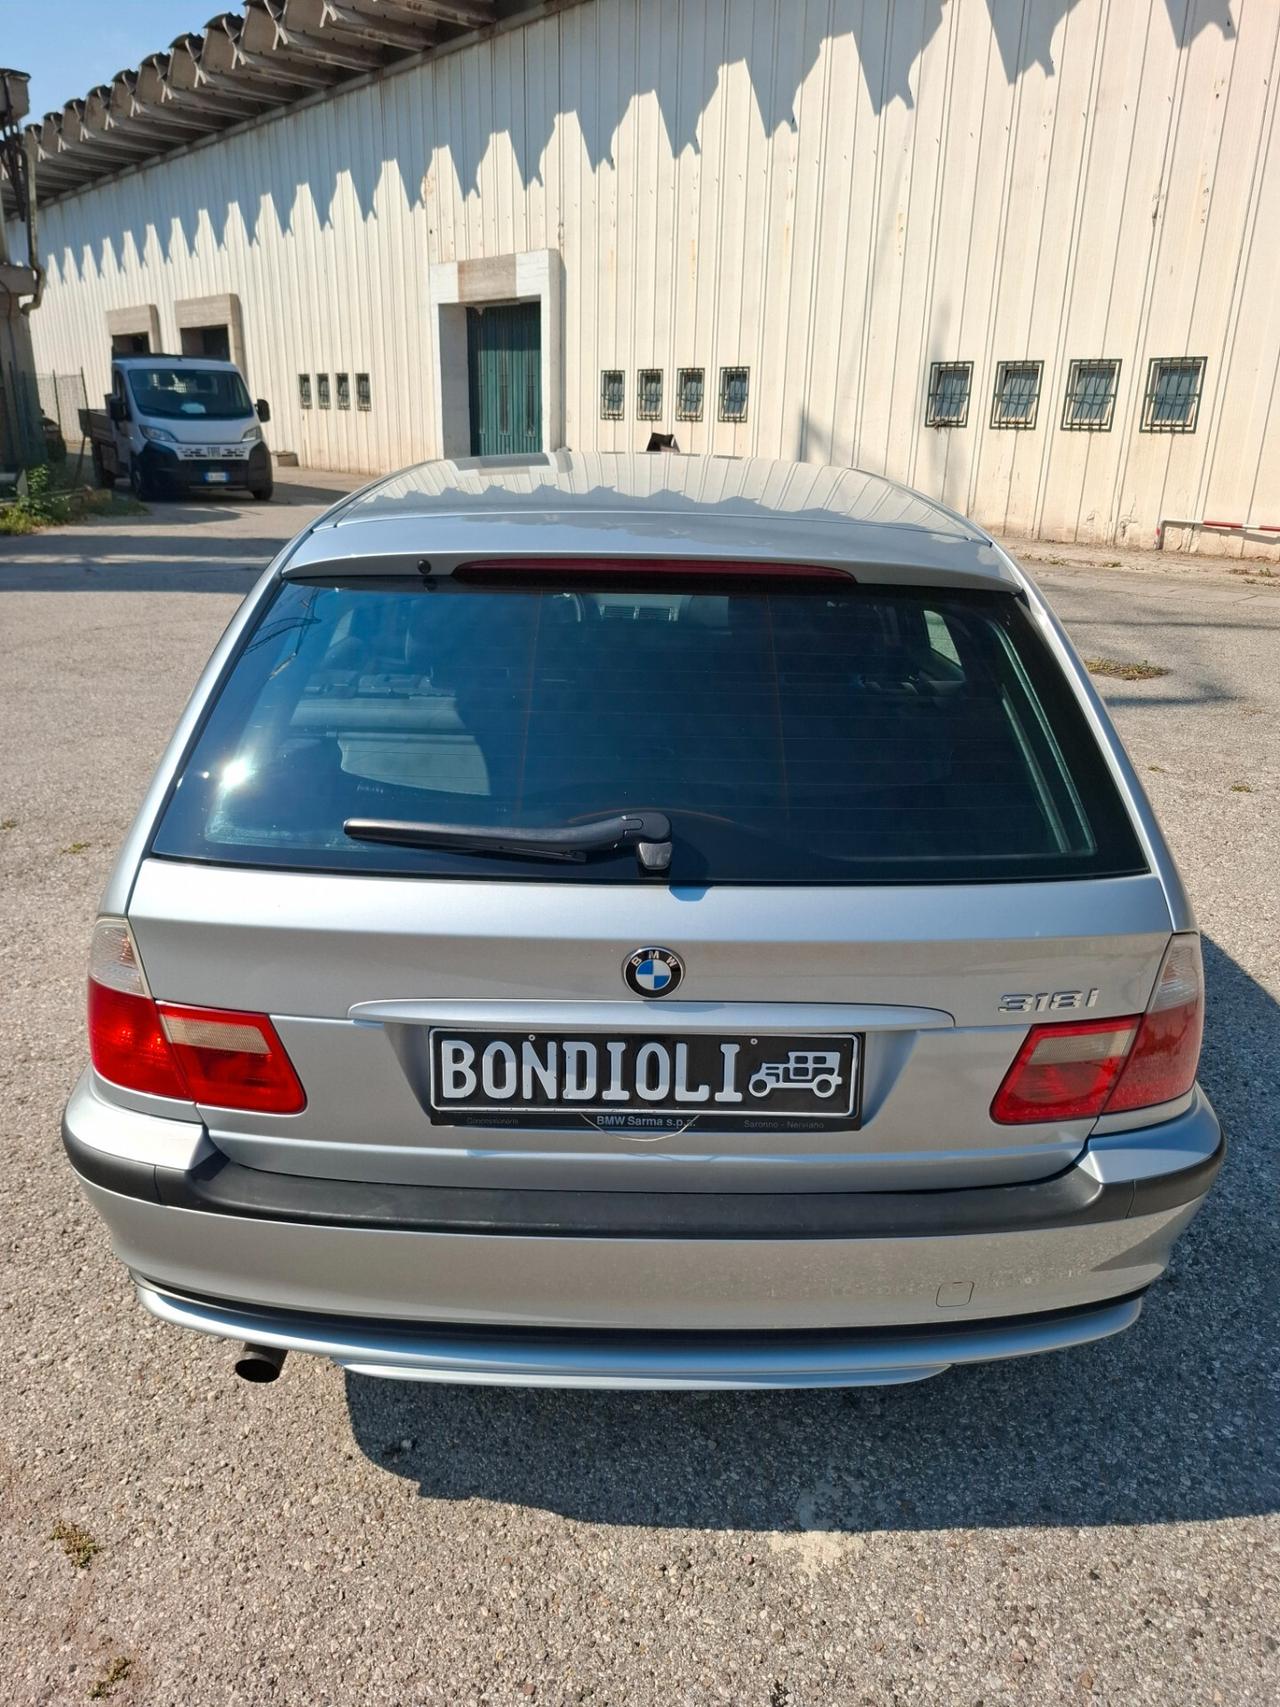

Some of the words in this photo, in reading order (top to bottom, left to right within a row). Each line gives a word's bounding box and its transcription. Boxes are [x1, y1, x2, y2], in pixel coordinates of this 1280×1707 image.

[631, 951, 678, 967] BMW
[998, 988, 1100, 1013] 318i
[441, 1040, 743, 1103] BONDIOLI
[596, 1115, 626, 1125] BMW
[627, 1116, 663, 1126] Sarma
